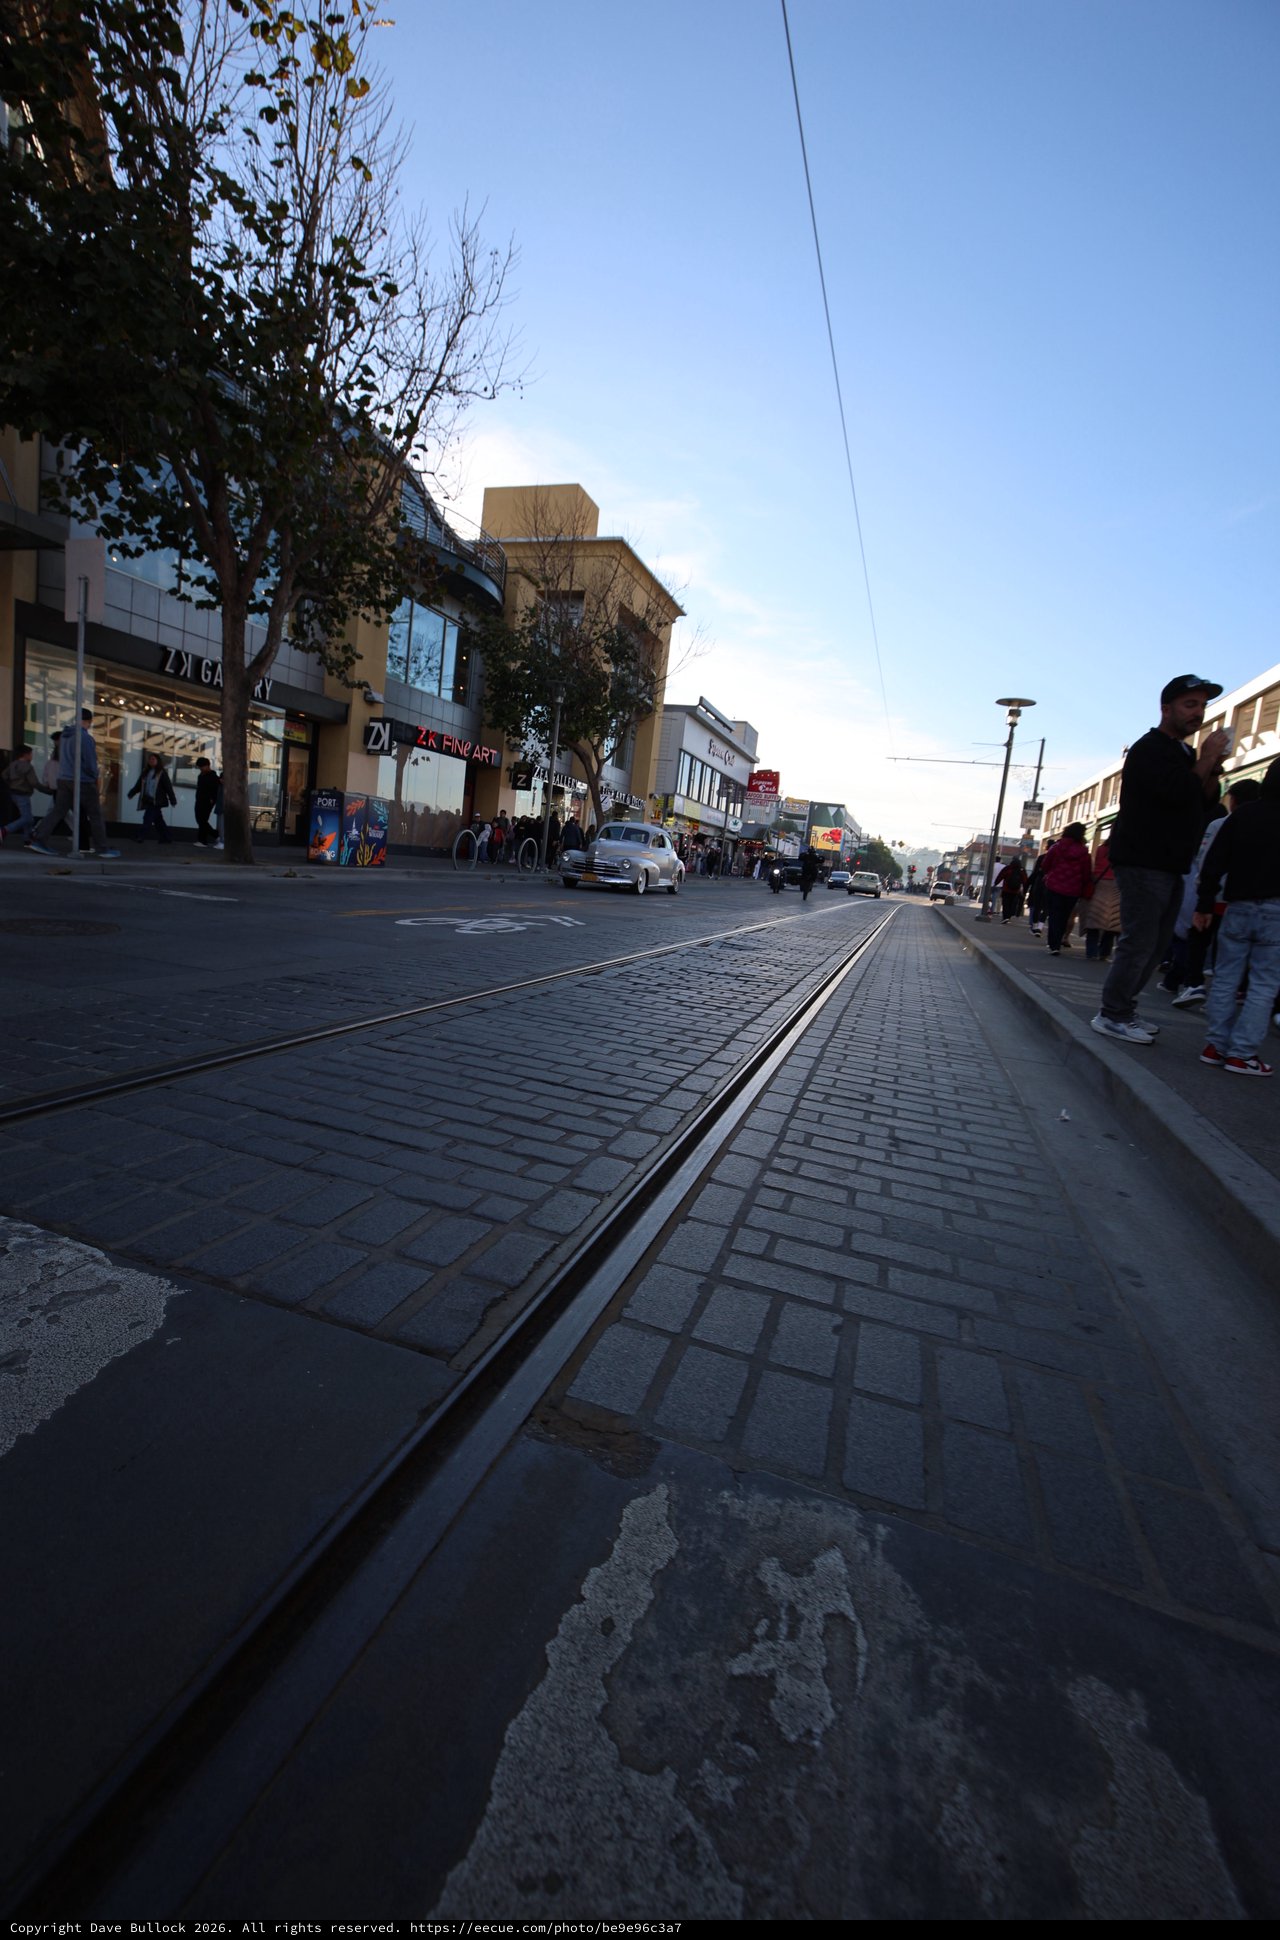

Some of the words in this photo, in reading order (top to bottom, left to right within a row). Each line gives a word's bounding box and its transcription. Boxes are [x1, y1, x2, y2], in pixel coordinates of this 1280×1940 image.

[201, 659, 272, 700] GARY
[416, 725, 438, 749] ZK
[472, 744, 497, 766] ART
[517, 774, 526, 787] Z
[533, 764, 549, 782] ZEA
[317, 797, 337, 807] PORT
